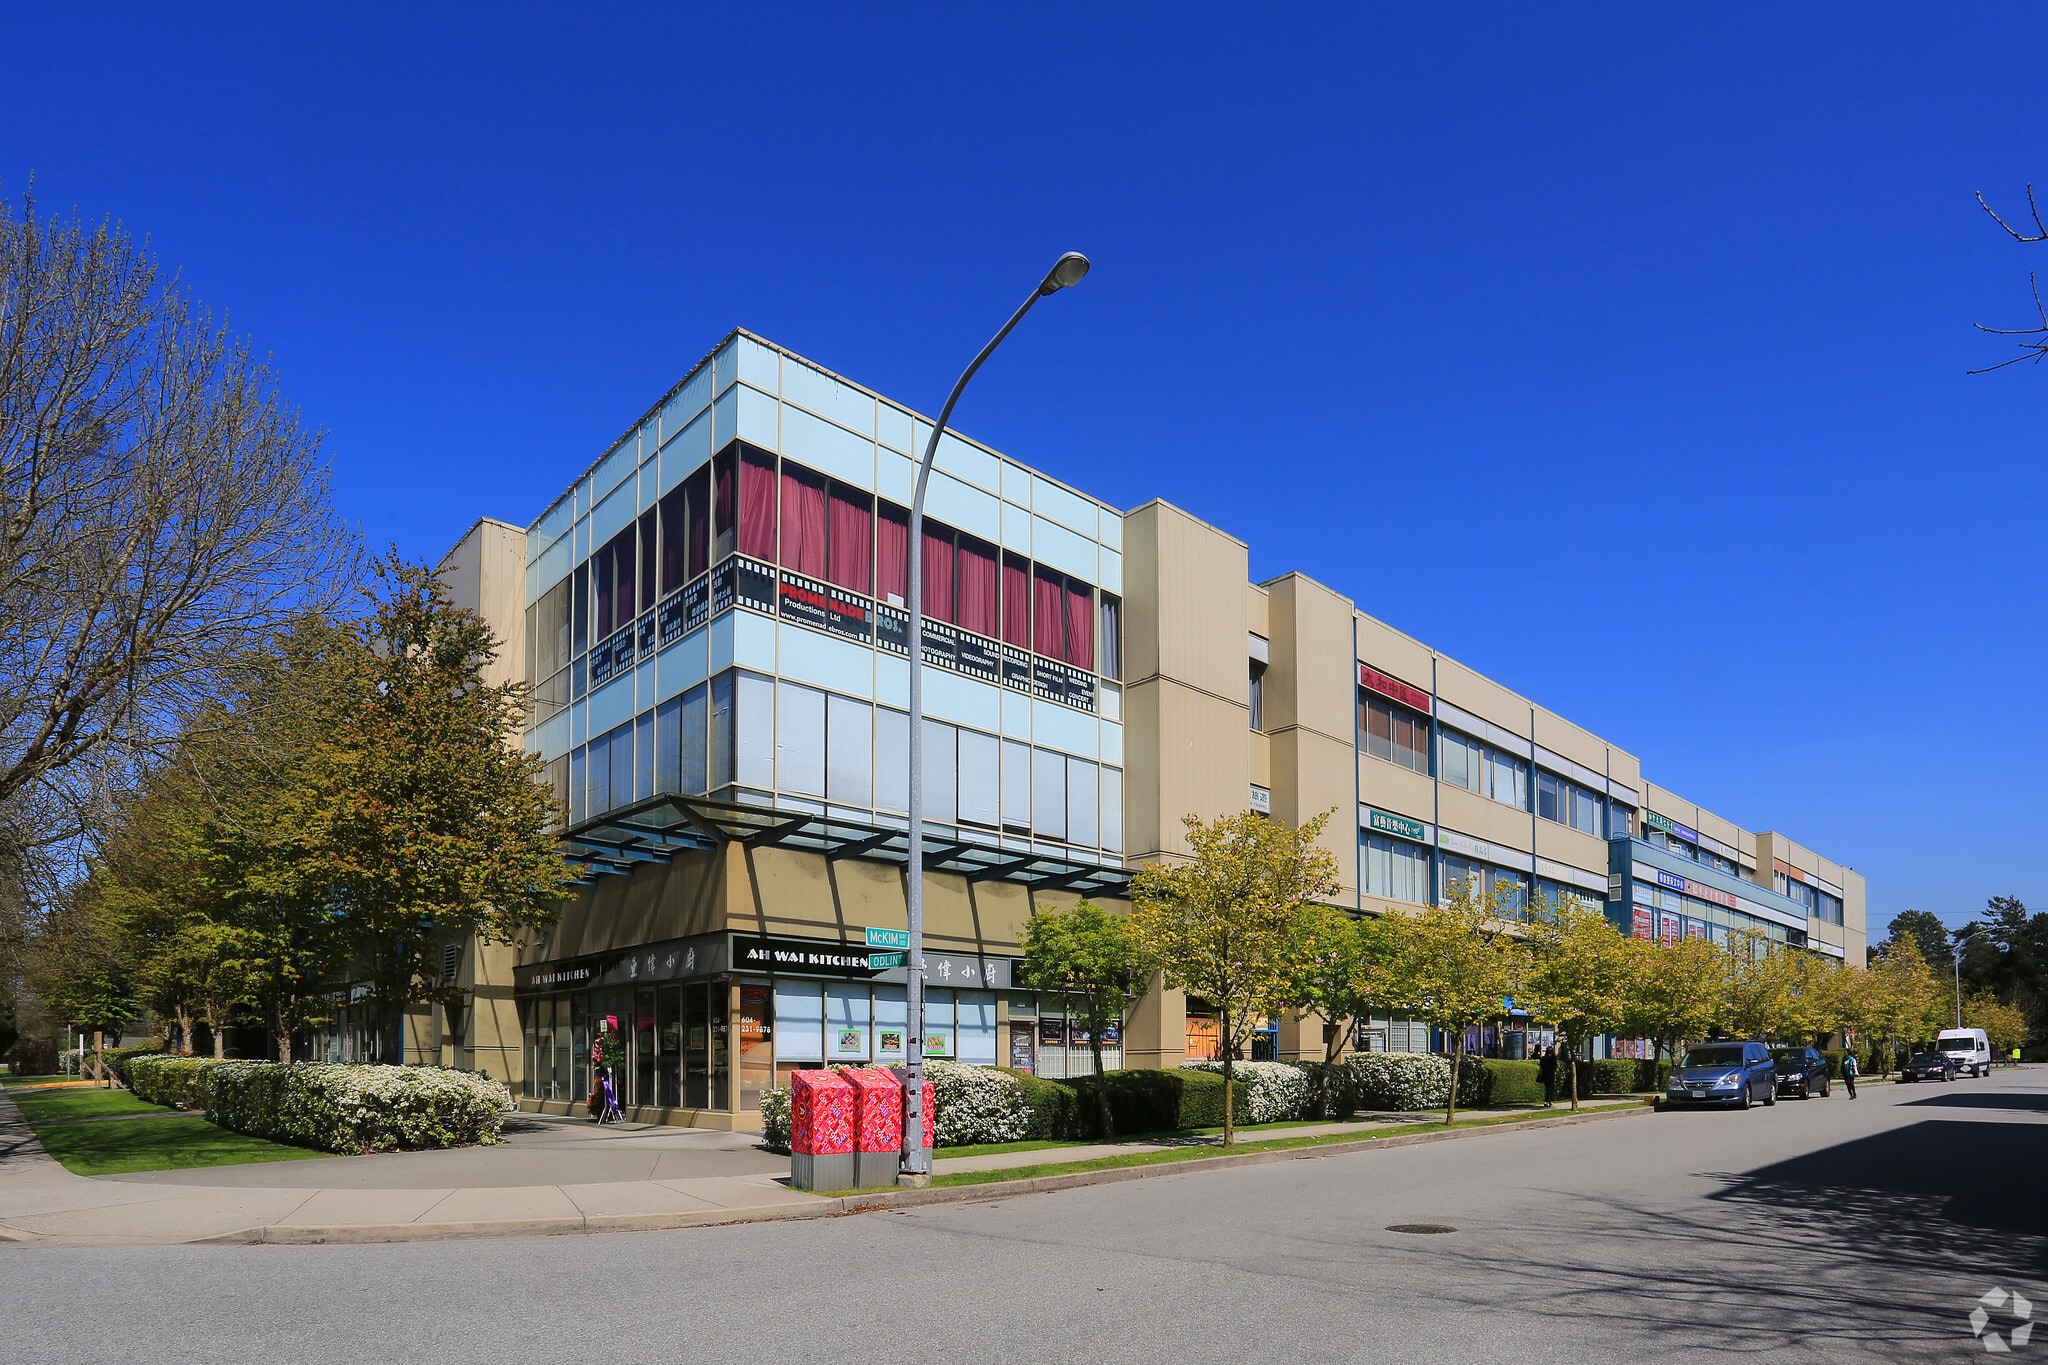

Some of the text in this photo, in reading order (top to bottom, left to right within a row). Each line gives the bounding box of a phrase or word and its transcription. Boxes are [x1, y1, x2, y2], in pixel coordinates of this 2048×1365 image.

[785, 598, 840, 622] Productions Ltd
[922, 631, 956, 645] COMMERCIAL
[921, 645, 956, 661] HOTOGRAPHY
[961, 652, 995, 667] VIDEOGRAPHY
[983, 649, 1000, 659] SOUND
[1011, 673, 1031, 684] GRAPHIC
[1036, 671, 1063, 684] SHORT FILM
[1068, 677, 1087, 688] WEDDING
[1068, 692, 1089, 702] CONCERT
[870, 930, 899, 945] McKIM
[747, 949, 869, 968] AH WAI KITCHEN
[873, 954, 899, 967] ODLIN
[531, 968, 590, 985] AH WAI KITCHEN
